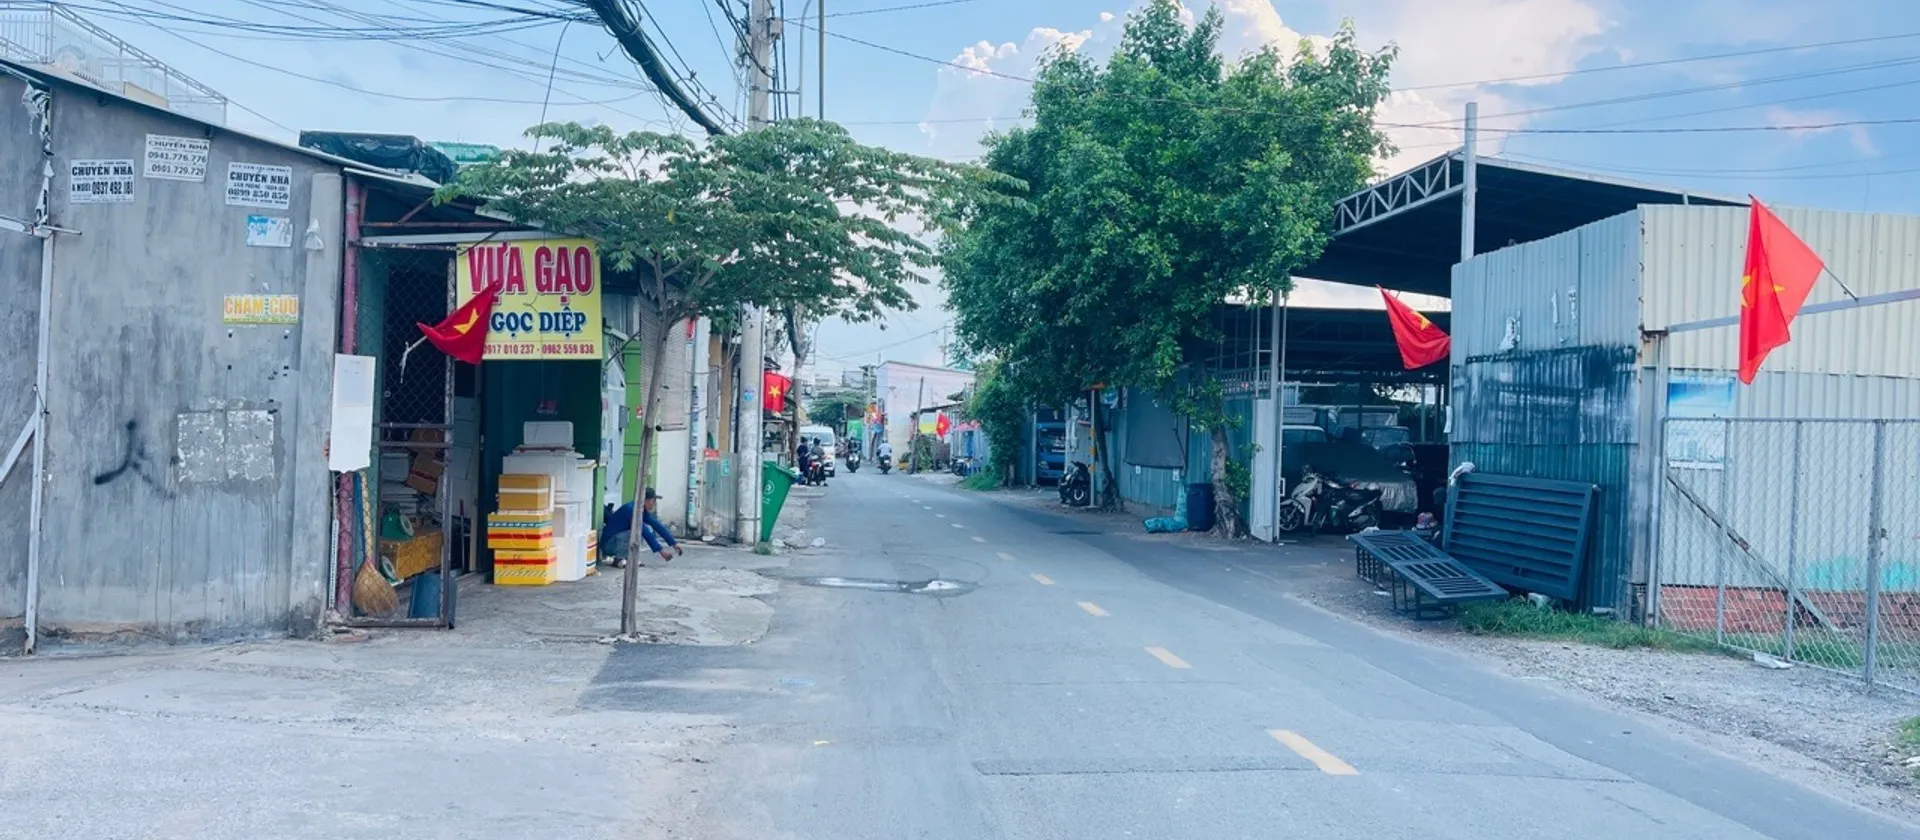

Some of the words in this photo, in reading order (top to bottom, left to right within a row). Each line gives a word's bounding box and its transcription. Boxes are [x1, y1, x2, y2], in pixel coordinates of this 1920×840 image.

[467, 241, 526, 305] VỰA
[534, 245, 594, 303] GẠO
[488, 311, 534, 337] GỌC
[539, 306, 587, 337] DIỆP
[520, 343, 535, 354] 237
